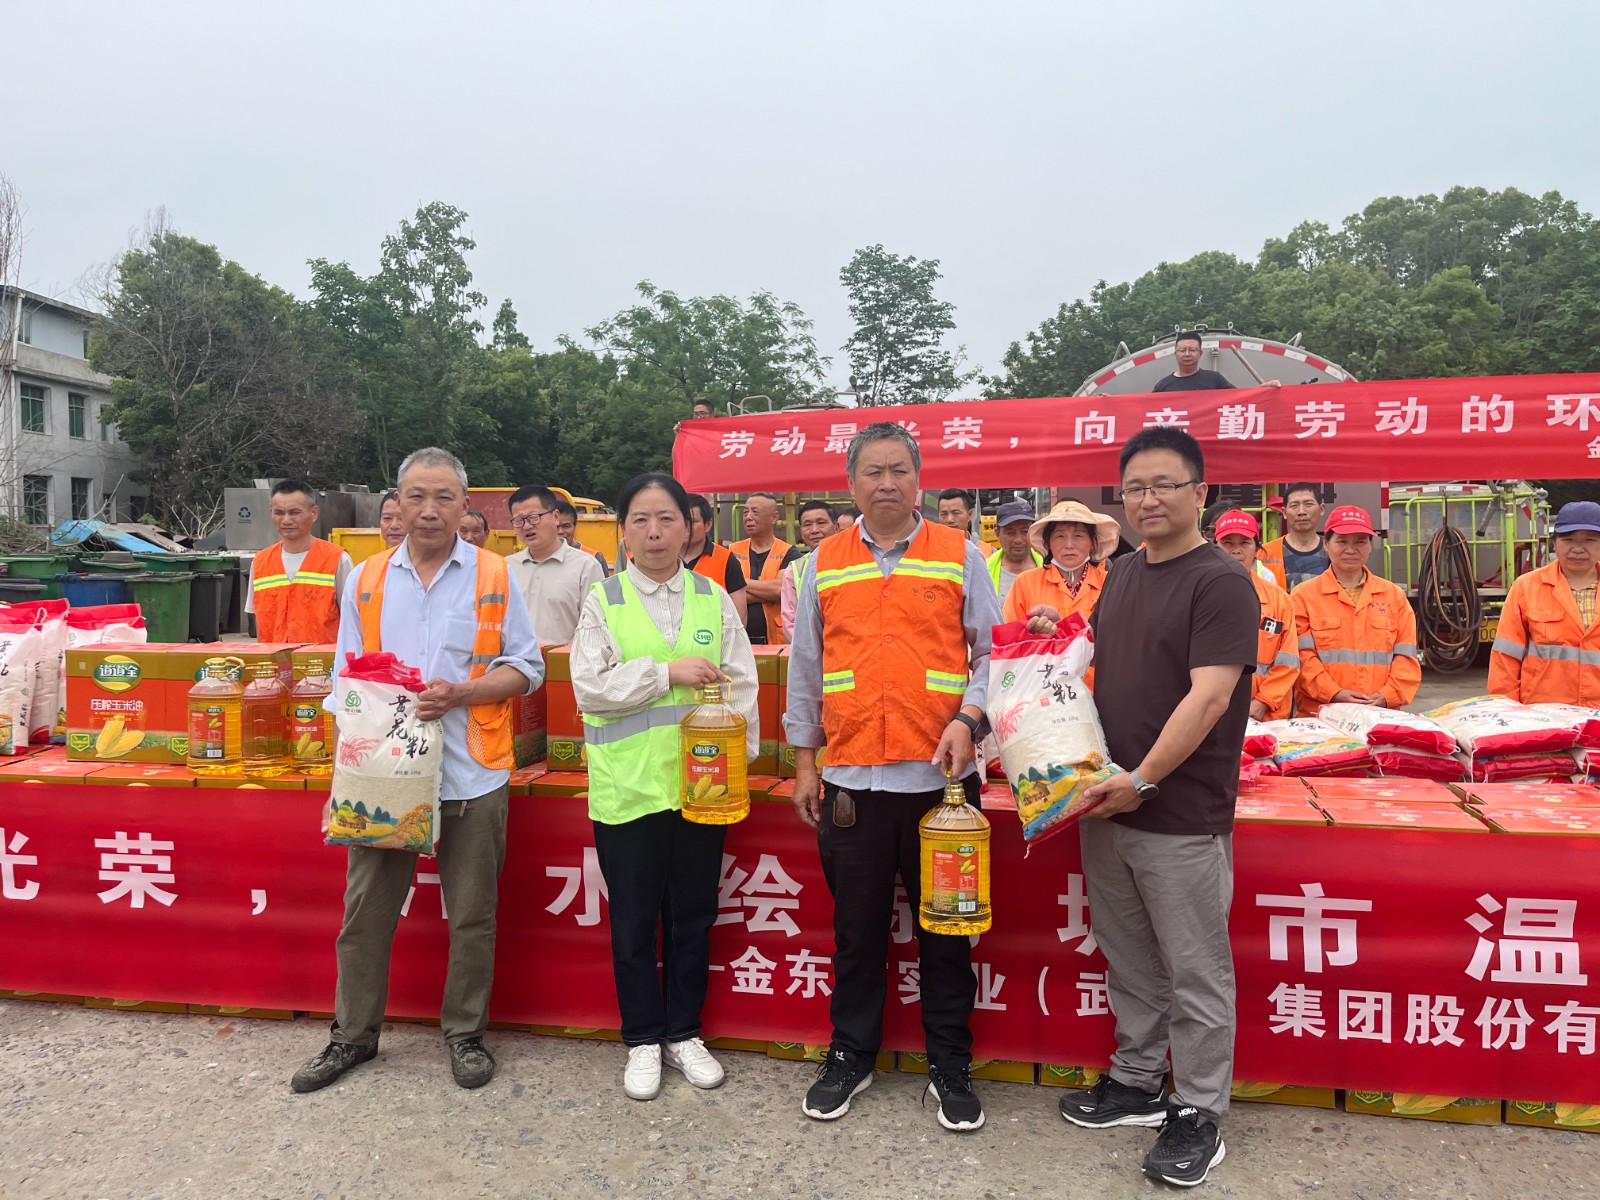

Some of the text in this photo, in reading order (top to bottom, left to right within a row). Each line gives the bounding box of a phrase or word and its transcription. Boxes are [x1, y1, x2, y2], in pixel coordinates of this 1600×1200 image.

[100, 664, 138, 678] 道道全
[91, 698, 144, 712] 压榨玉米油
[1178, 1107, 1198, 1117] HOKA
